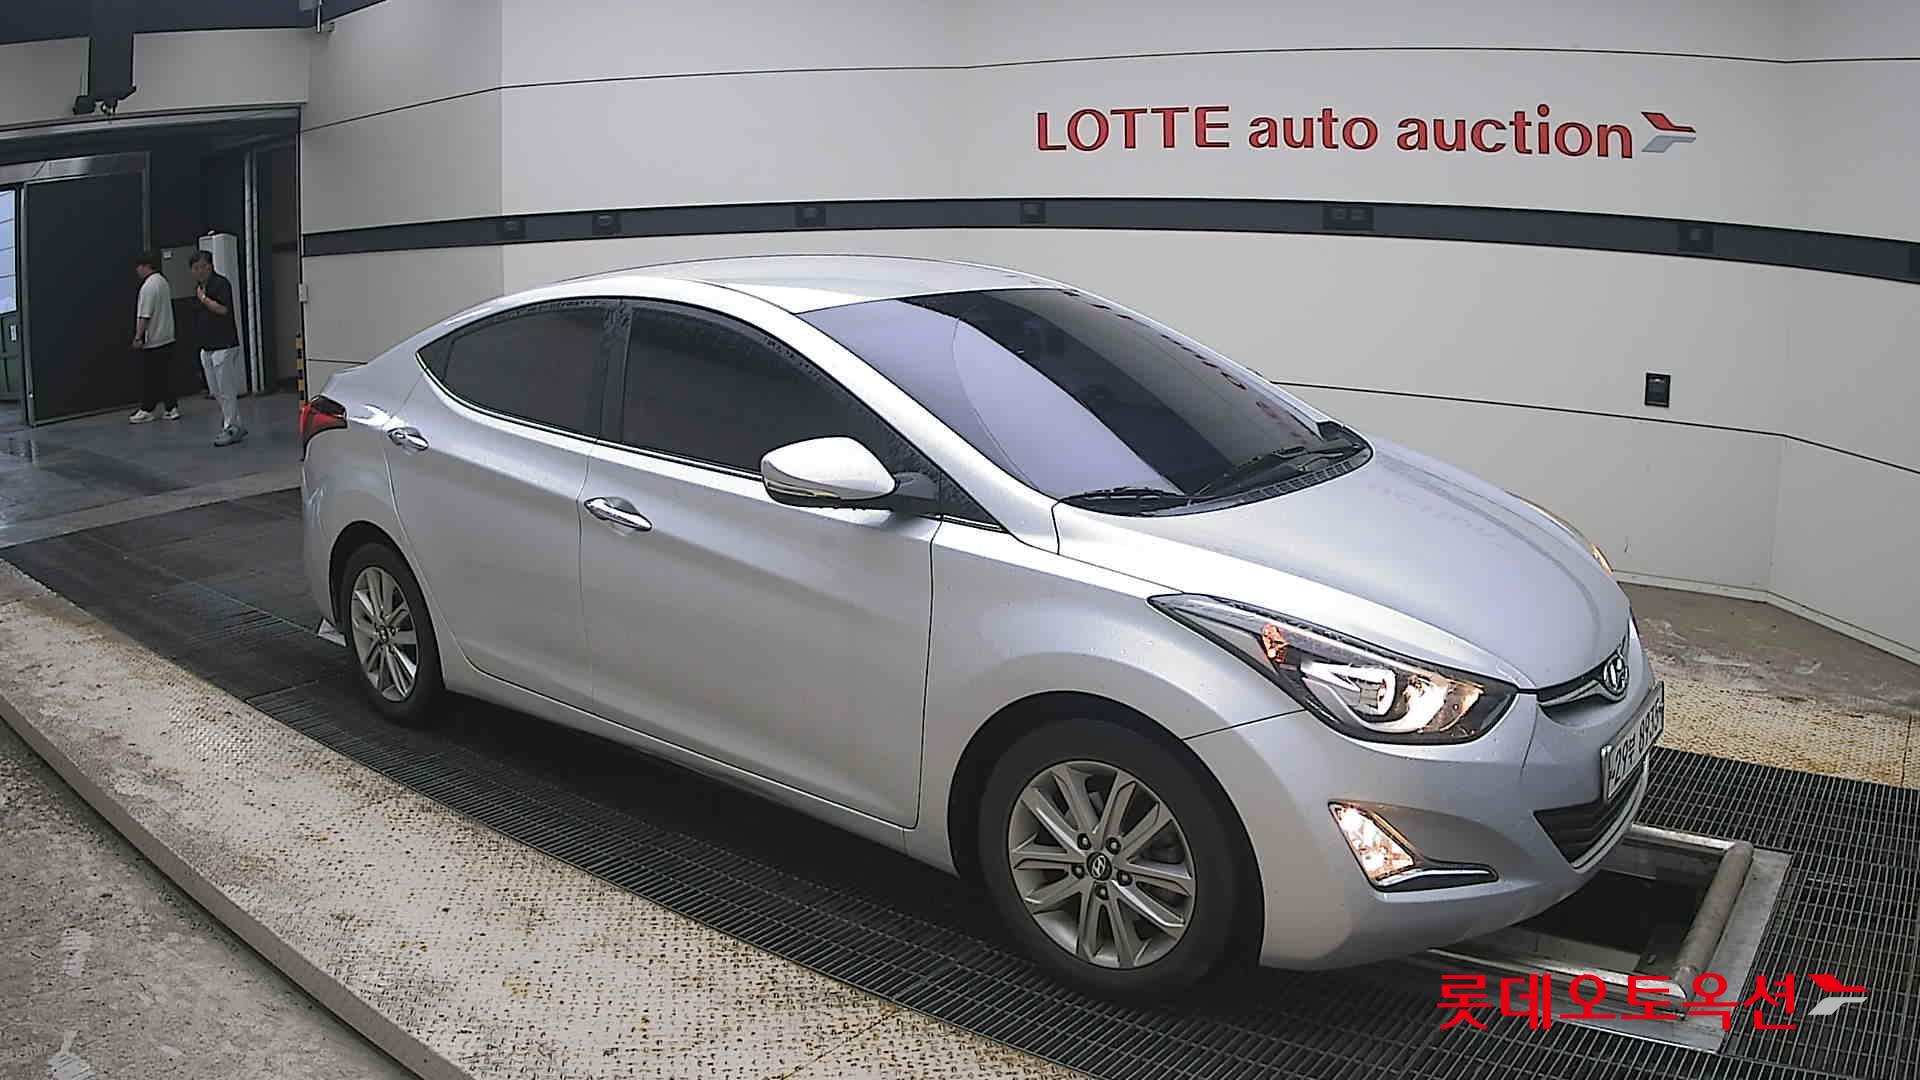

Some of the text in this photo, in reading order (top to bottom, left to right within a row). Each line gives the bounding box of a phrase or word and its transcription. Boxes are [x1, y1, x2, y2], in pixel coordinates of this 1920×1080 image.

[1037, 104, 1633, 159] LOTTE auto auction
